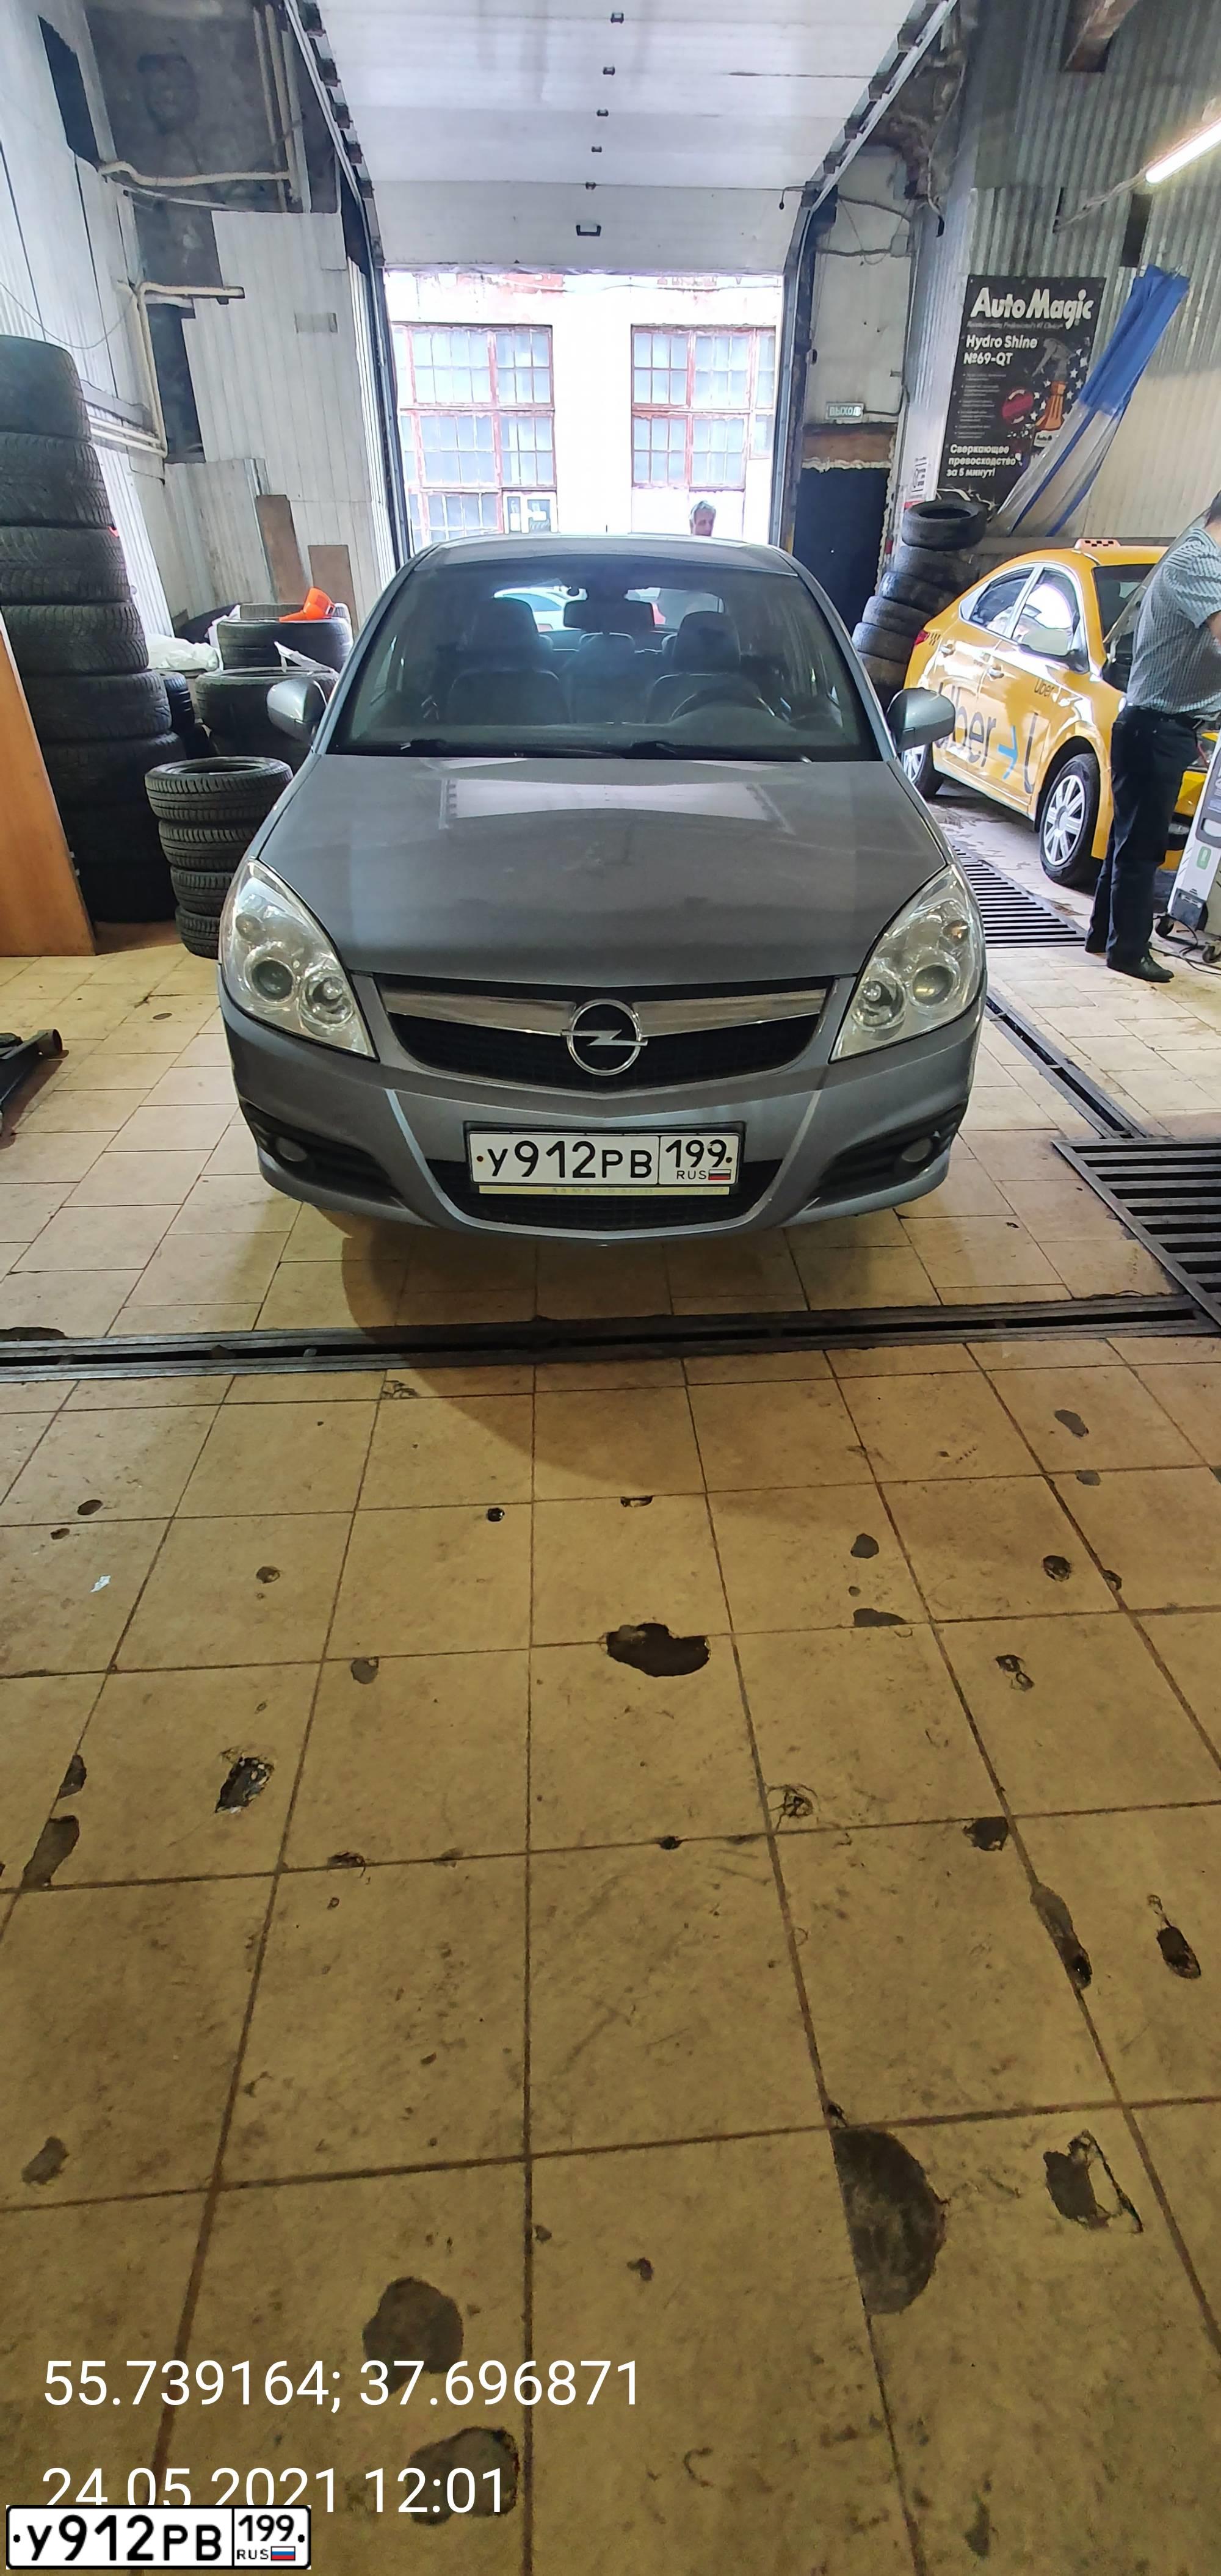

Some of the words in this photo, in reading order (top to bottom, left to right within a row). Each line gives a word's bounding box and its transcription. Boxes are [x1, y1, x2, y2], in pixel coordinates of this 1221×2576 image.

[966, 335, 1002, 350] Hydro
[1004, 335, 1038, 348] Shine
[950, 444, 1010, 455] Сверкающее
[948, 457, 1016, 466] превосходство
[965, 468, 996, 478] минут!
[487, 1141, 652, 1178] У912РВ
[665, 1139, 727, 1168] 199
[677, 1170, 706, 1180] RUS
